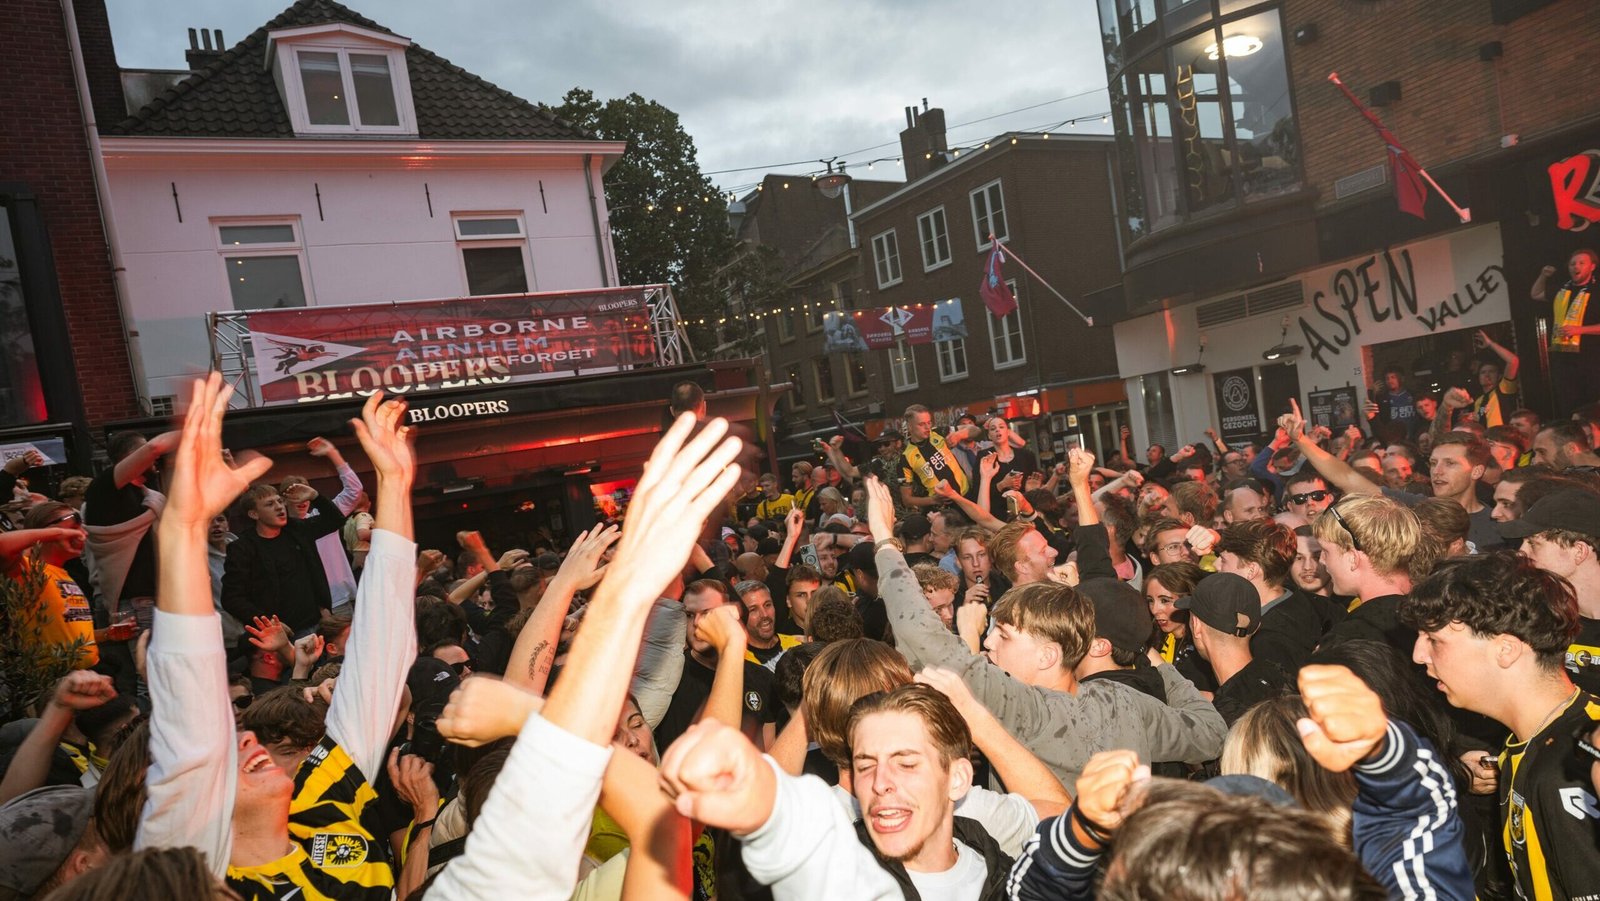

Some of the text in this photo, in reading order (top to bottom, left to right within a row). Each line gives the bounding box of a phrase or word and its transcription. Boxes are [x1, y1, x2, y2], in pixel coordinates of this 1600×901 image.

[598, 298, 638, 313] BLOOPERS
[1299, 249, 1418, 371] ASPEN
[392, 316, 591, 344] AIRBORNE
[395, 336, 549, 361] ARNHEM
[399, 348, 595, 375] LEST WE FORGET
[295, 355, 512, 403] BLOOPERS
[408, 400, 510, 423] BLOOPERS
[1222, 414, 1257, 423] PERSONEEL
[1222, 420, 1257, 430] GEZOCHT
[313, 834, 326, 865] VITESSE
